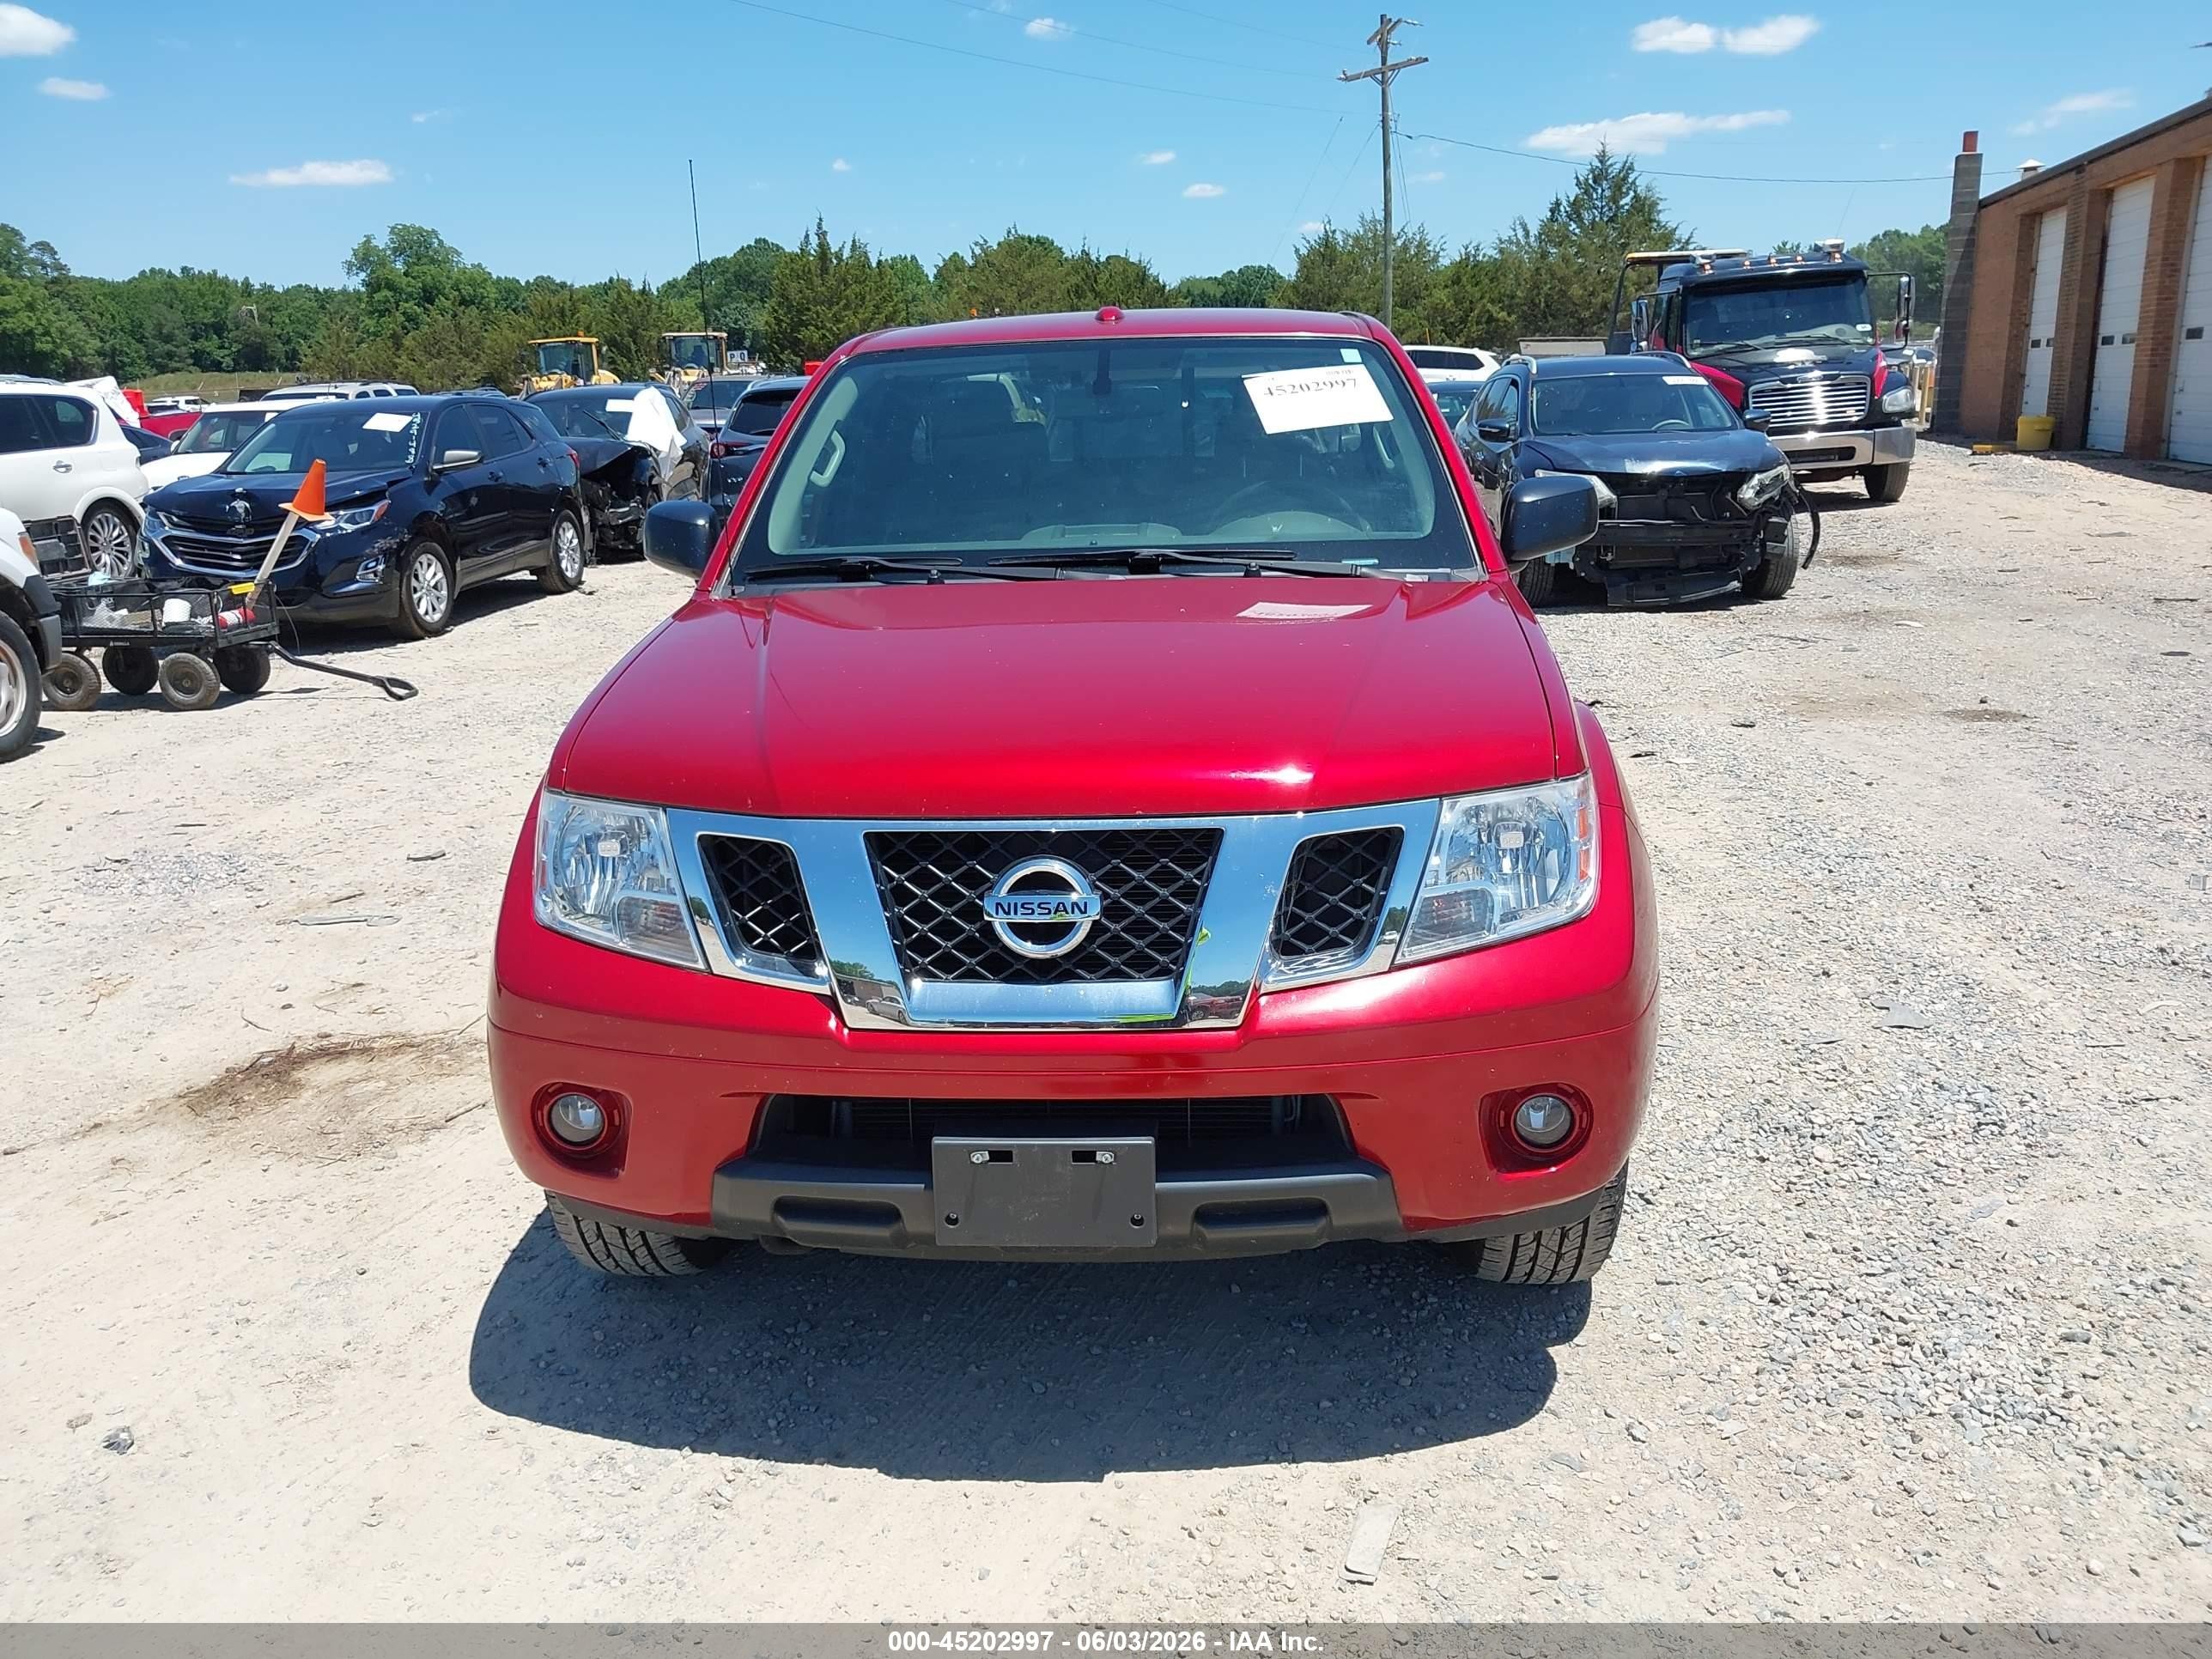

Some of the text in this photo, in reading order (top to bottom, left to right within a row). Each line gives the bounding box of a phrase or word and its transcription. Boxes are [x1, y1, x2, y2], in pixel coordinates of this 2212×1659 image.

[729, 353, 736, 362] P
[1264, 378, 1357, 397] 45202997
[994, 901, 1089, 916] NISSAN
